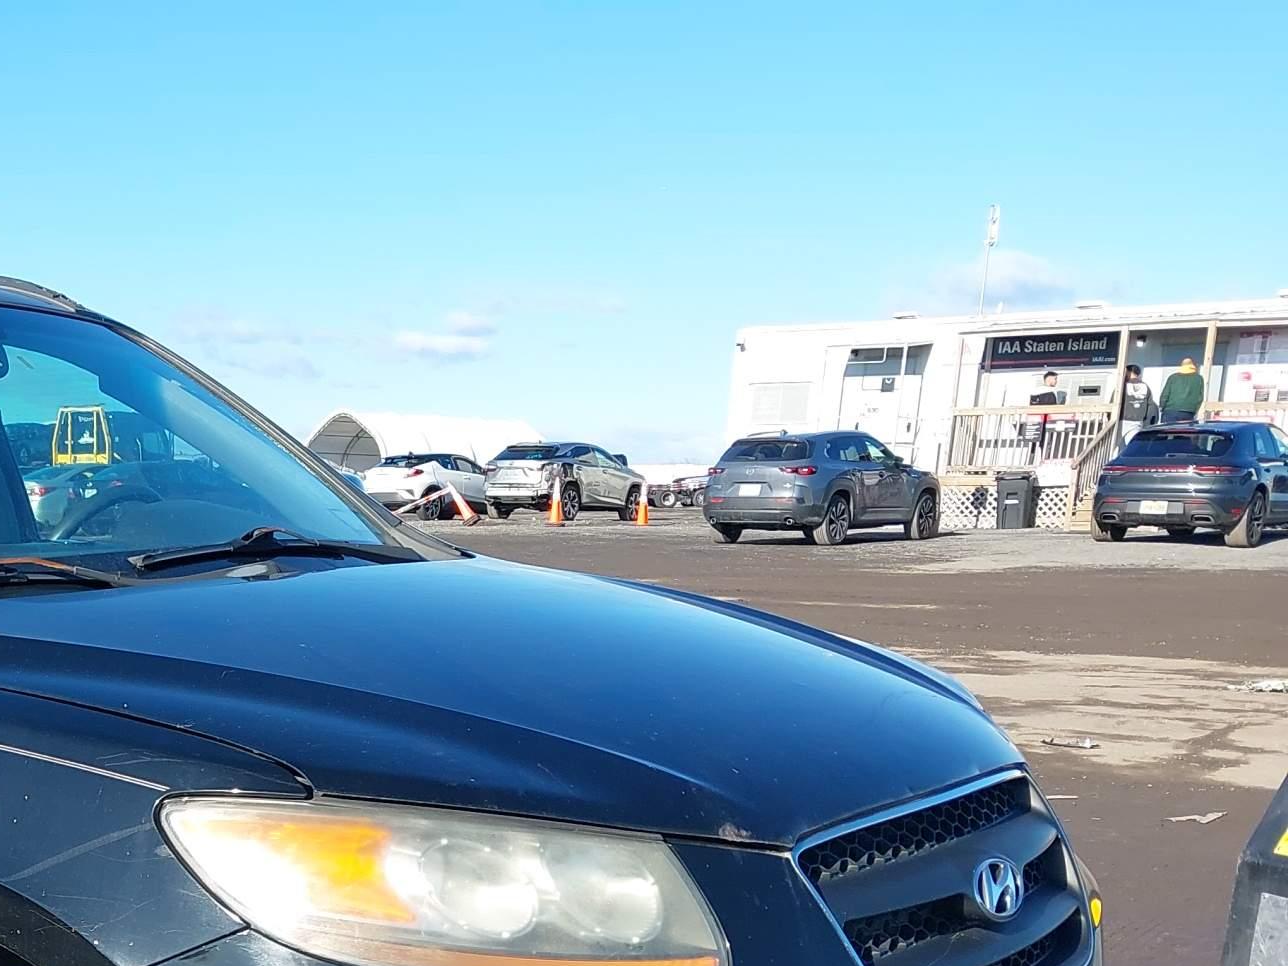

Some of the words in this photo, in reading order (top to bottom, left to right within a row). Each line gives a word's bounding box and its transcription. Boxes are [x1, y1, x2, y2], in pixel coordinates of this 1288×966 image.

[998, 340, 1021, 354] IAA
[1024, 339, 1064, 353] Staten
[1068, 337, 1108, 351] Island
